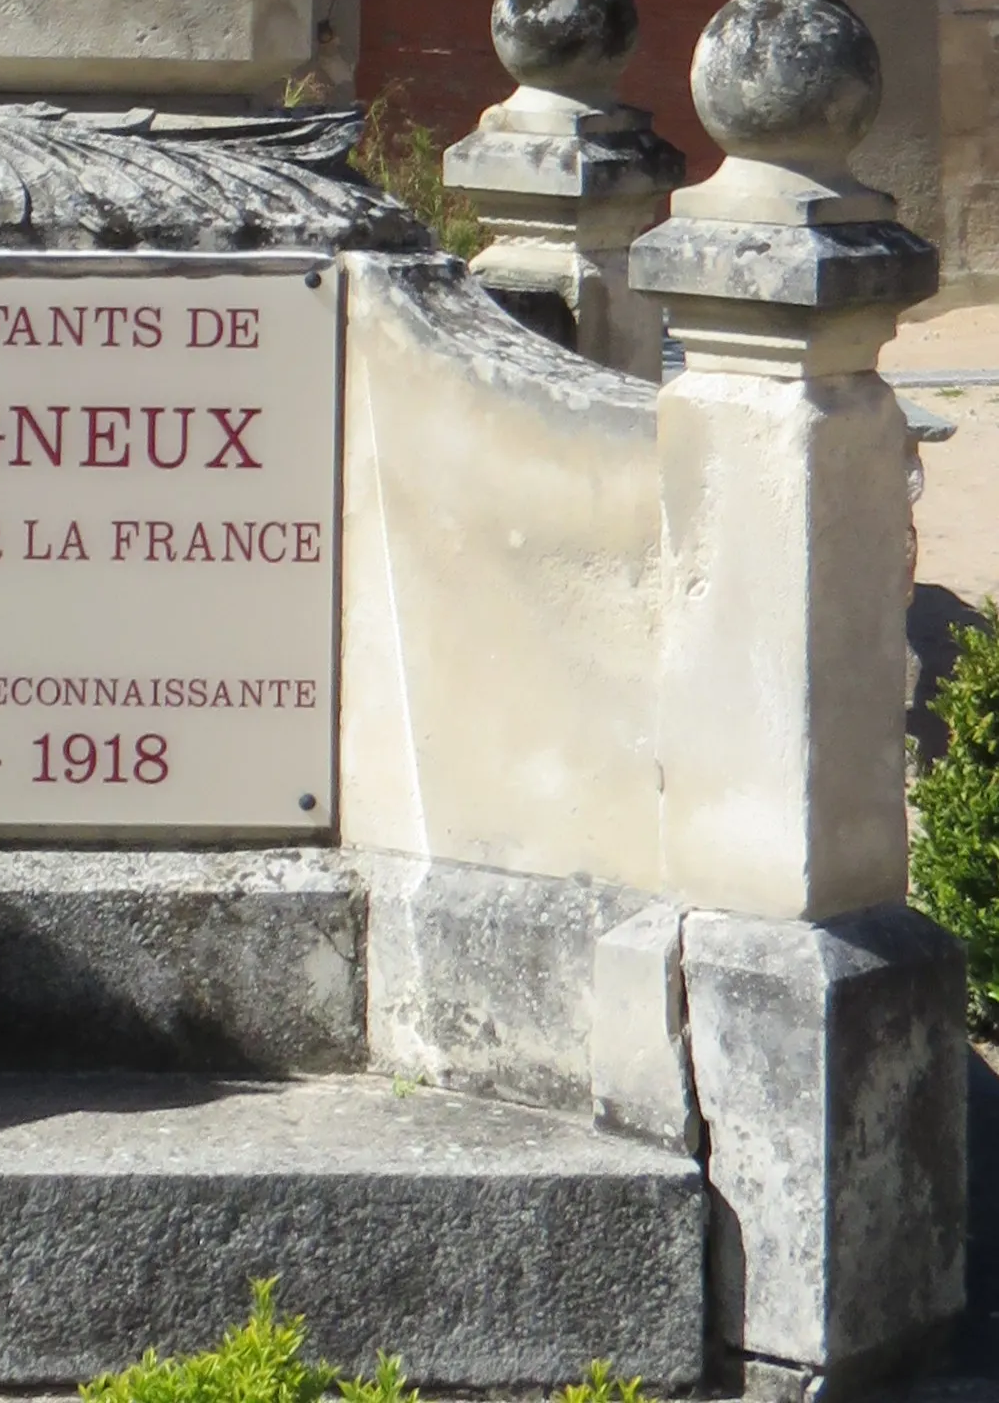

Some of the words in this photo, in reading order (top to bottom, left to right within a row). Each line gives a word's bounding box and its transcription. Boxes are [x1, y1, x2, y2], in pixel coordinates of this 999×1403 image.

[186, 308, 260, 348] DE
[24, 521, 89, 561] LA
[111, 521, 322, 563] FRANCE
[33, 733, 169, 784] 1918
